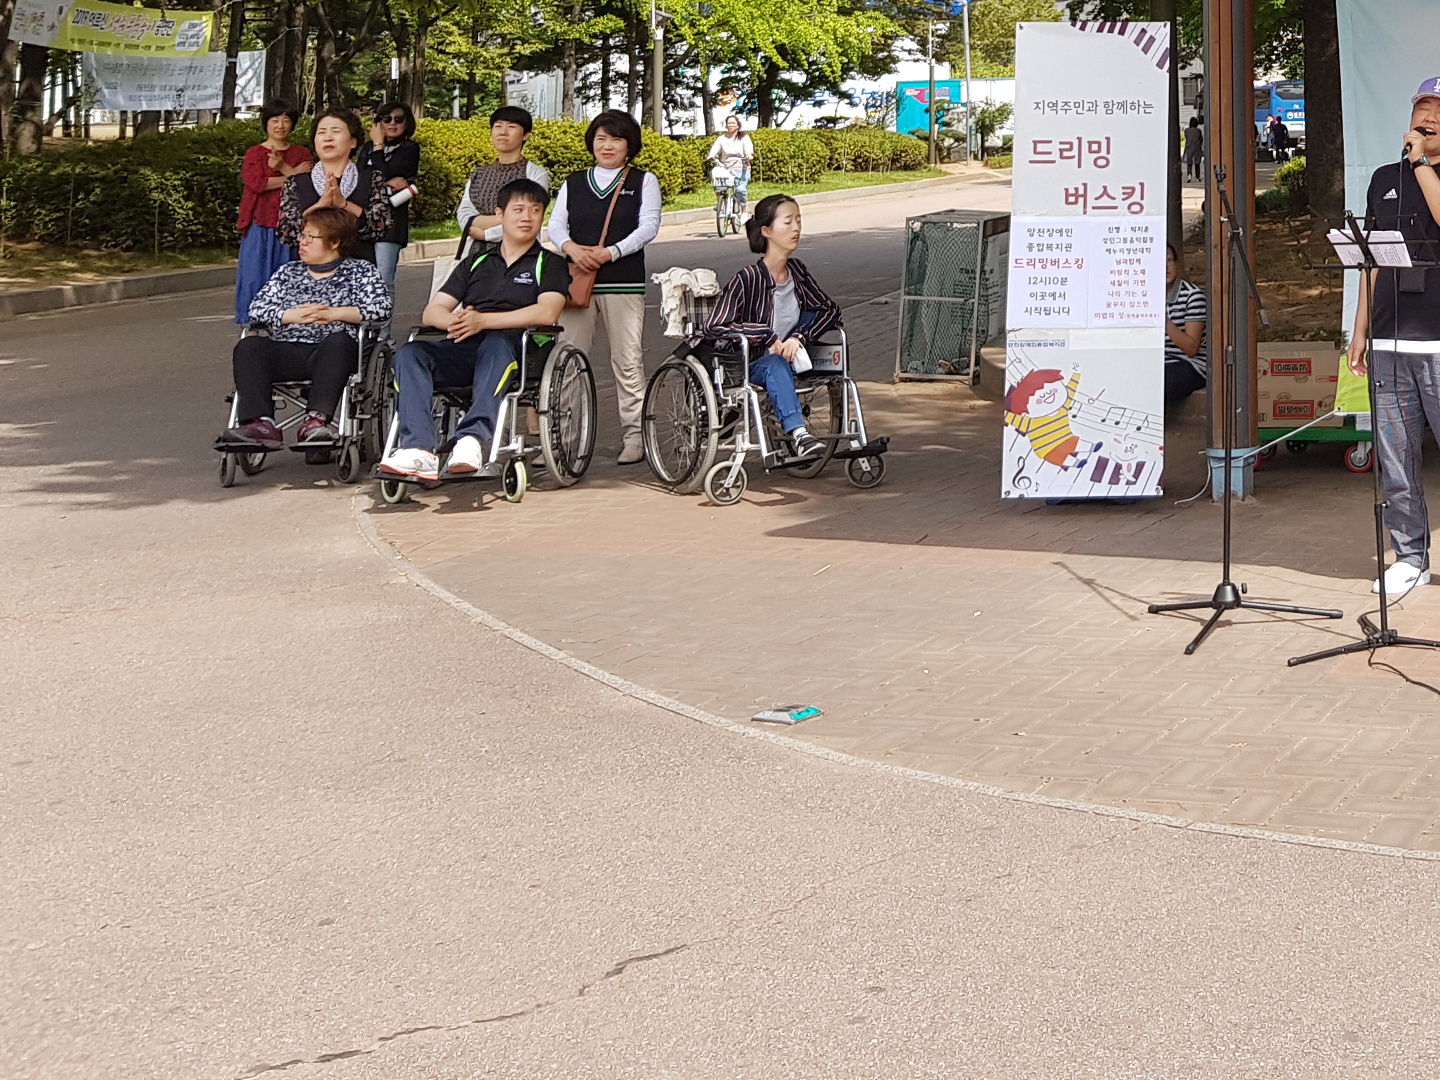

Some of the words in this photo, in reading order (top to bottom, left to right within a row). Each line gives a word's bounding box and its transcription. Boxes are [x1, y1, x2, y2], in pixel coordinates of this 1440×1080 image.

[1033, 99, 1099, 115] 지역주민과
[1103, 99, 1155, 115] 함께하는
[1028, 136, 1112, 169] 드리밍
[1063, 182, 1146, 215] 버스킹
[1027, 228, 1073, 237] 양천장애인
[1026, 242, 1073, 252] 종합복지관
[1013, 257, 1084, 269] 드리밍버스킹
[1028, 276, 1068, 286] 12시10분
[1023, 306, 1071, 316] 시작됩니다
